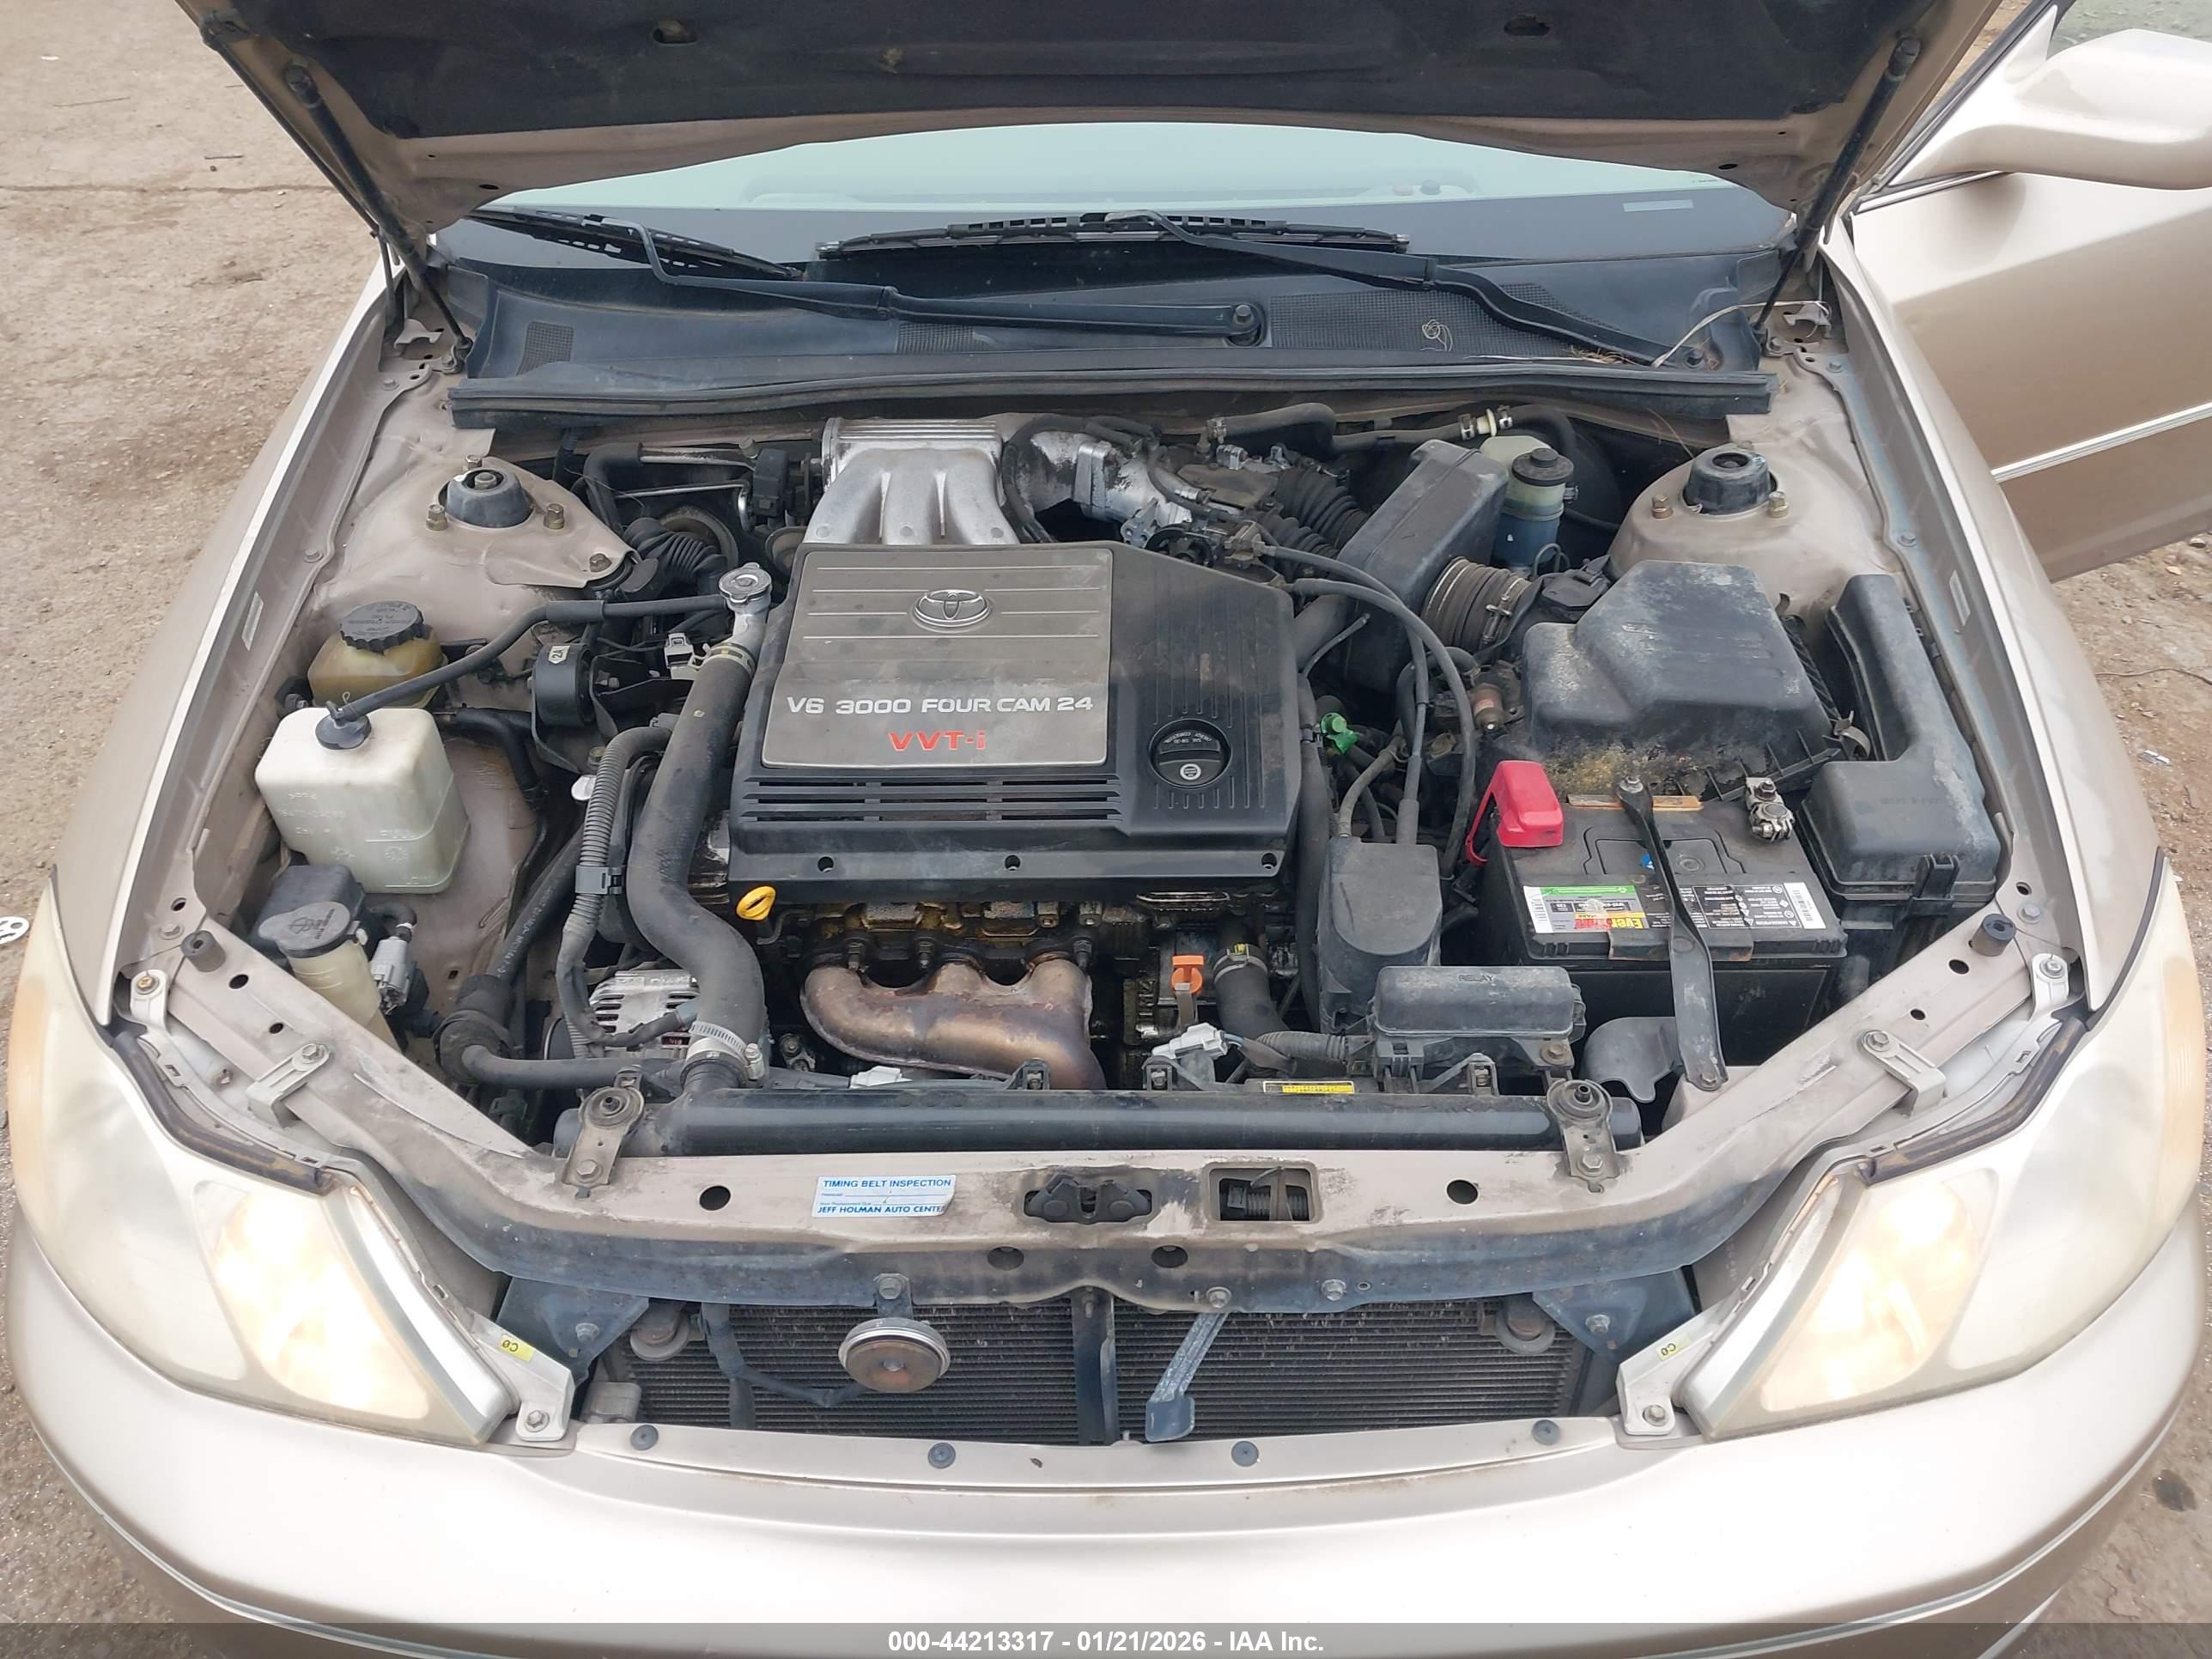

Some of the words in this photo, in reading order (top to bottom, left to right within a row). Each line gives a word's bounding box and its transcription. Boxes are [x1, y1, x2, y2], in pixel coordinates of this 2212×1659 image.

[787, 696, 824, 714] V6
[836, 697, 911, 714] 3000
[921, 696, 991, 714] FOUR
[996, 696, 1051, 713] CAM
[1056, 696, 1093, 712] 24
[889, 730, 987, 752] VVT-i
[884, 1205, 910, 1213] AUTO
